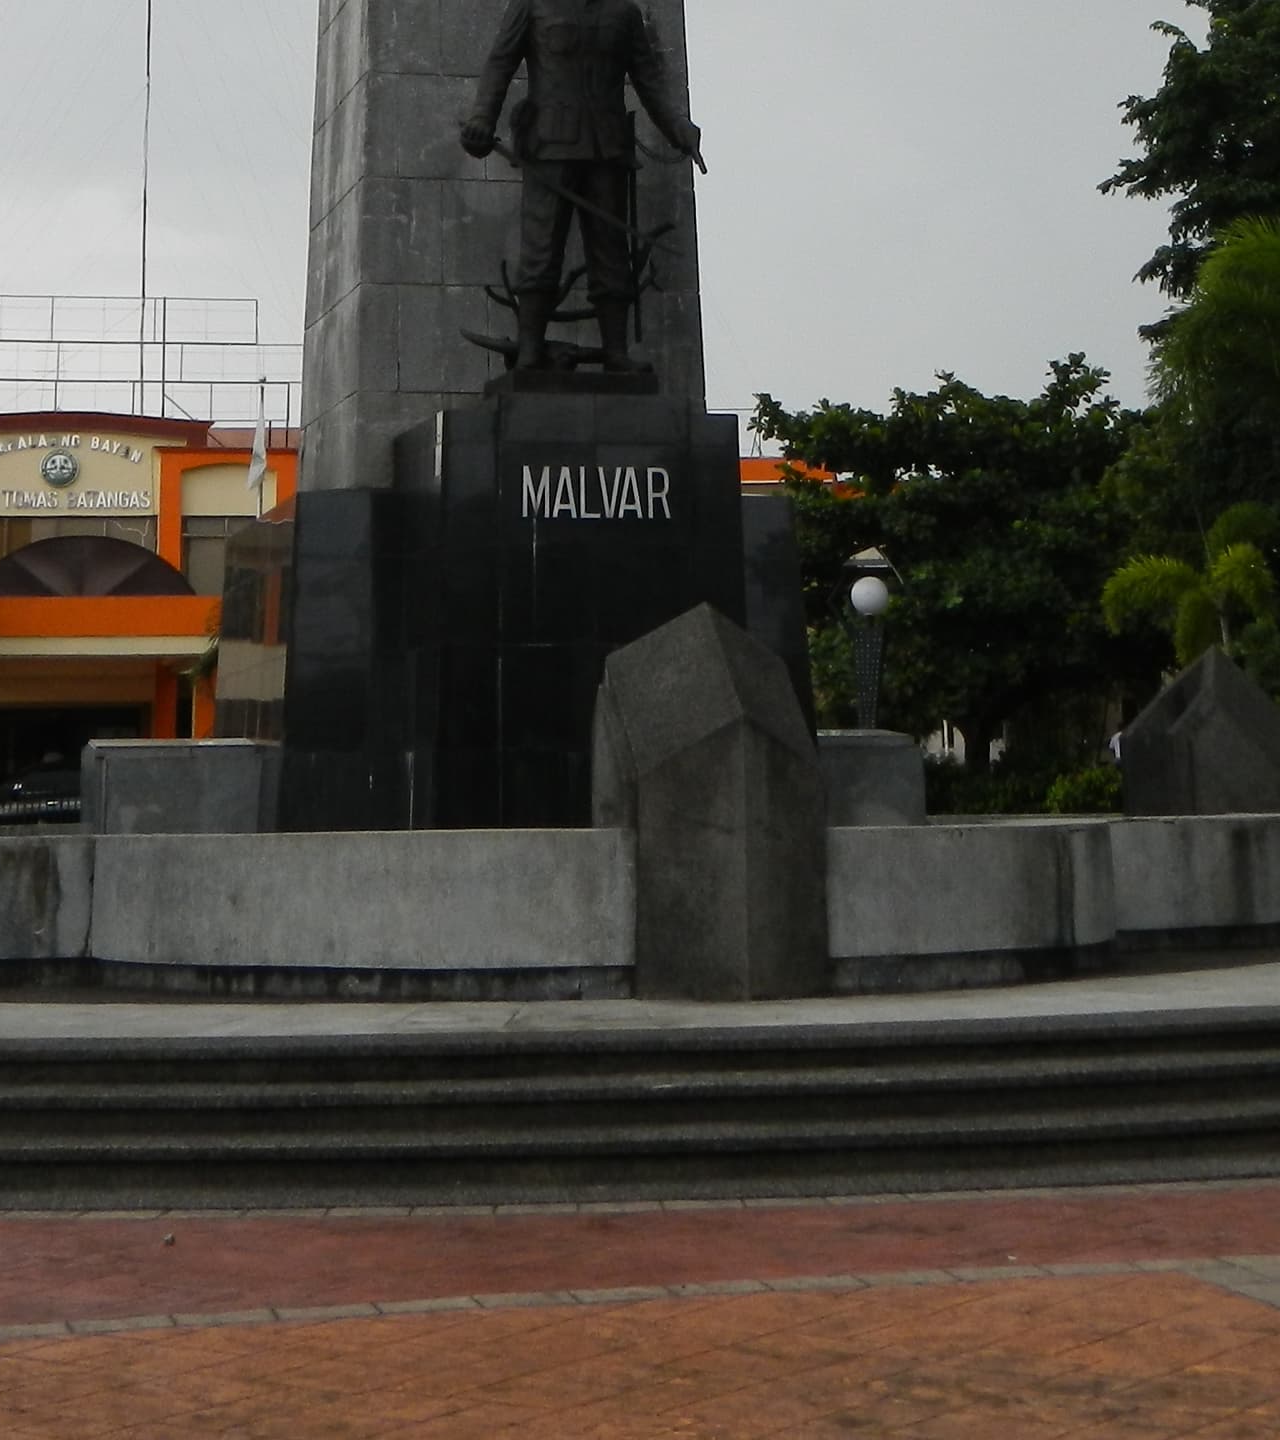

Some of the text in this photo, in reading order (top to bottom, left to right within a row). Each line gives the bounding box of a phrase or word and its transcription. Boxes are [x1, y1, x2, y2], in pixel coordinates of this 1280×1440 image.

[90, 436, 144, 465] BAYAN
[67, 490, 151, 510] BATANGAS
[521, 464, 671, 519] MALVAR
